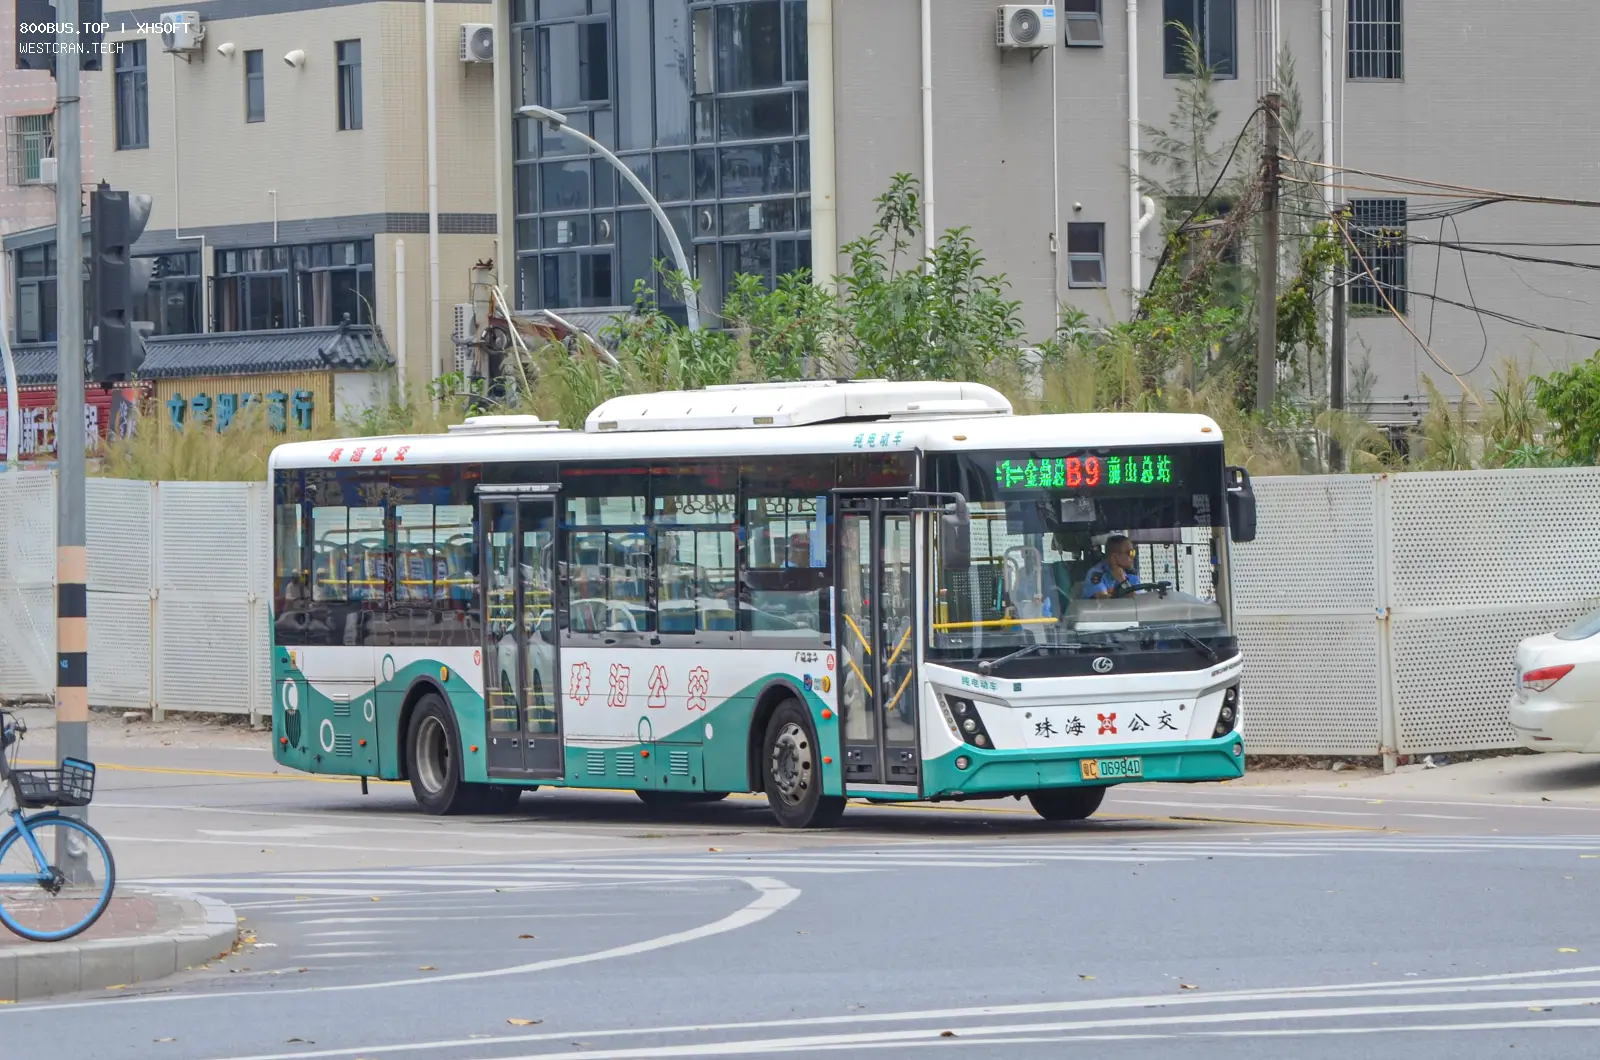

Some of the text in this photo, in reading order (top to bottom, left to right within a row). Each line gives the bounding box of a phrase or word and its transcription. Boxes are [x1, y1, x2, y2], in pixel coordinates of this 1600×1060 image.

[1066, 456, 1100, 488] B9
[1107, 455, 1171, 485] 前山总站
[570, 662, 710, 710] 珠海公交
[961, 675, 998, 691] 纯电动车
[1034, 710, 1179, 739] 珠海 公交
